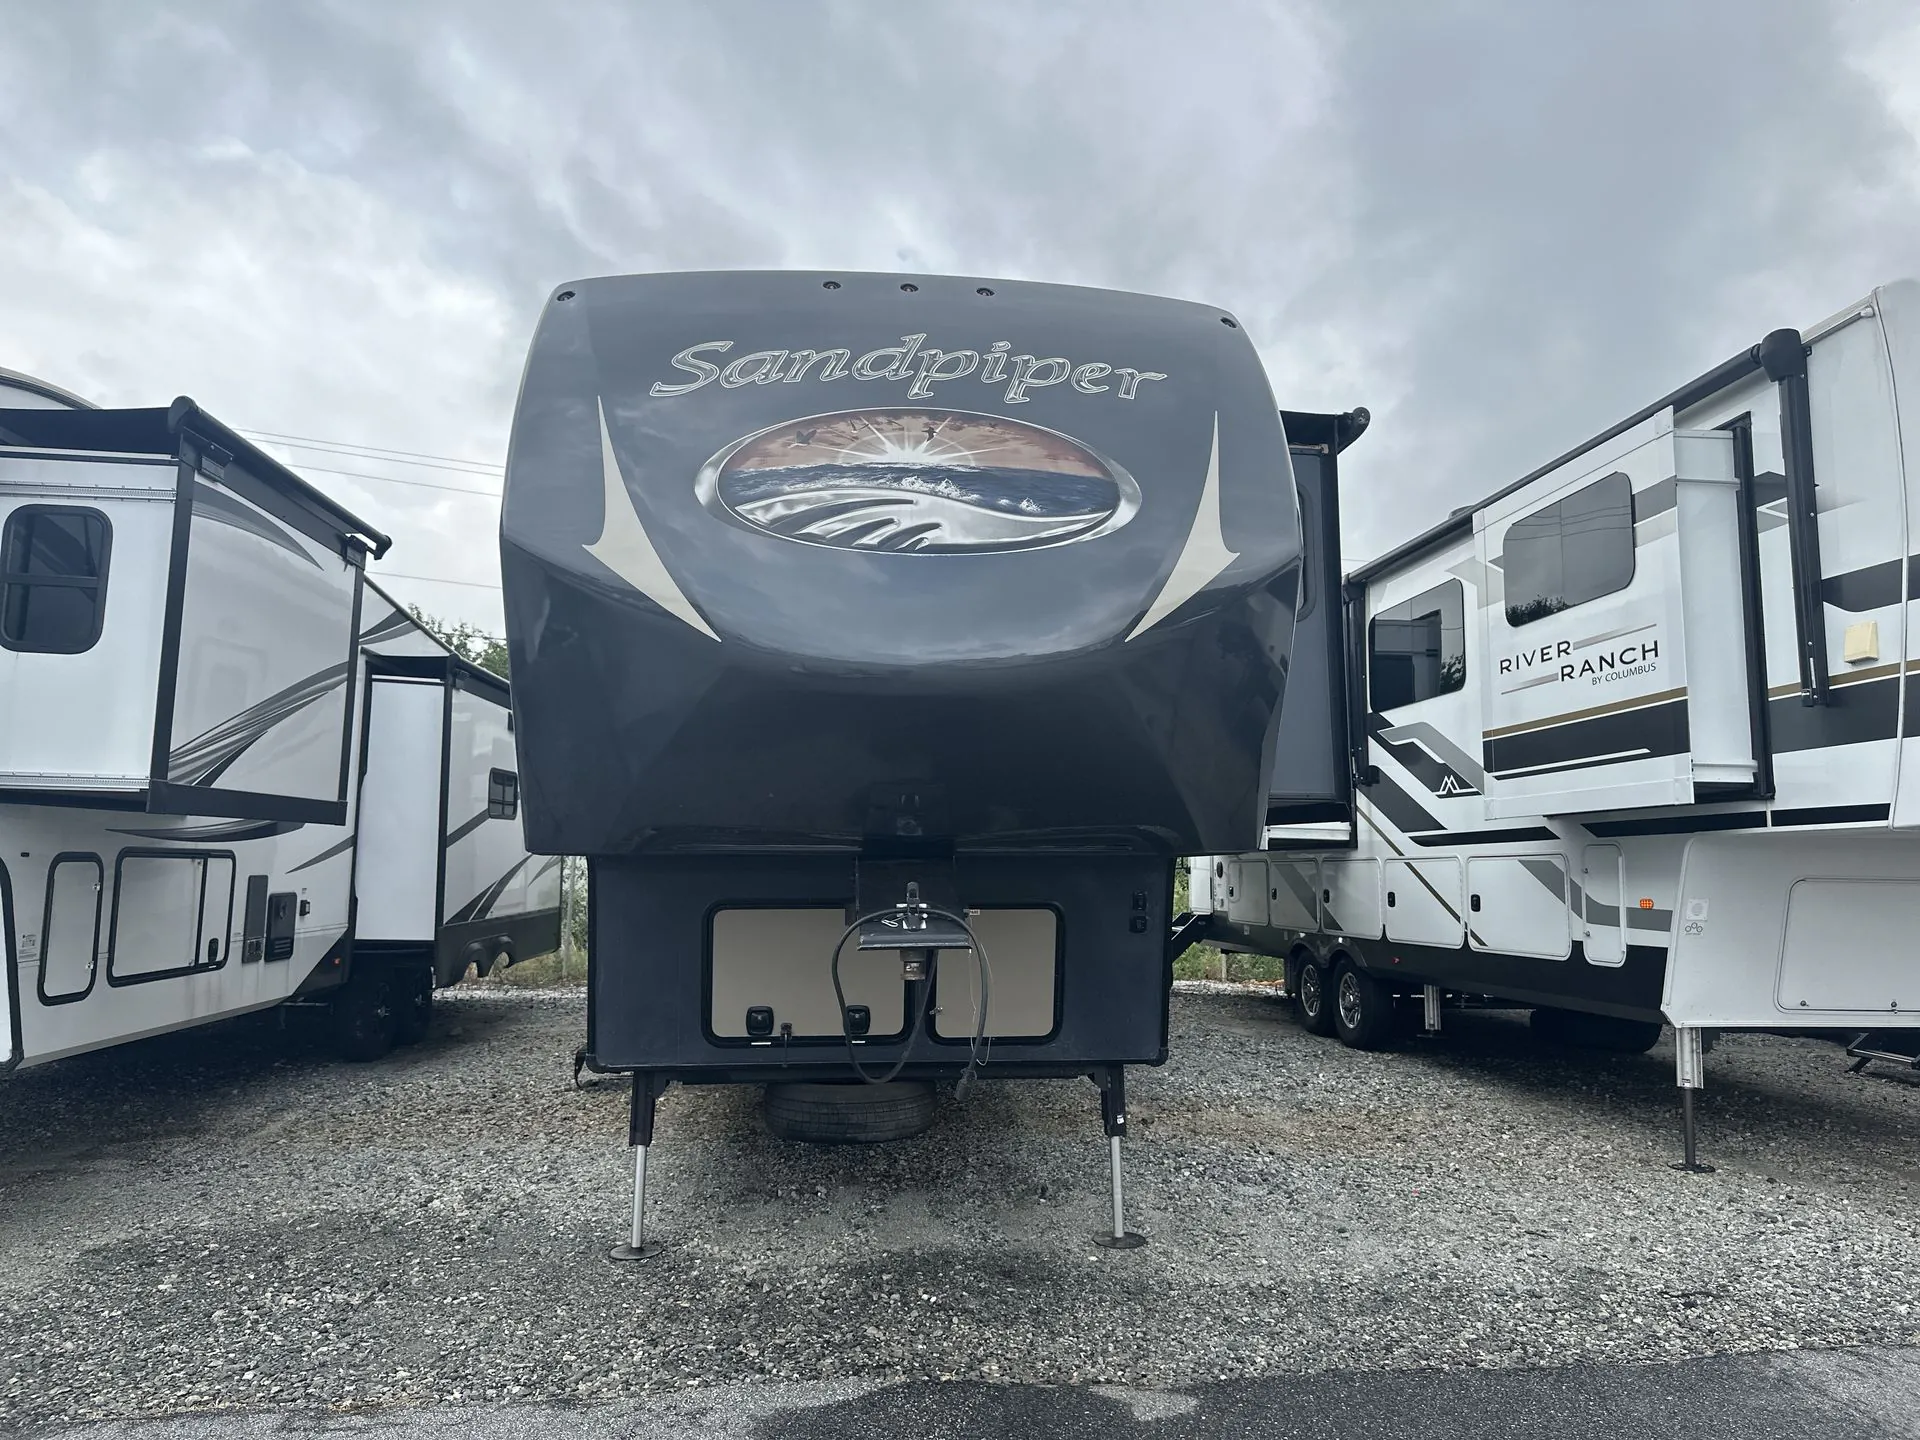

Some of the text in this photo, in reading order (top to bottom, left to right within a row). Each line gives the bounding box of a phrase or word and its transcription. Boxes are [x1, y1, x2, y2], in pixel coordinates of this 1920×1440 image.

[649, 333, 1167, 403] Sandpiper
[1500, 640, 1572, 674] RIVER
[1561, 640, 1659, 681] RANCH
[1592, 662, 1657, 686] BY COLUMBUS
